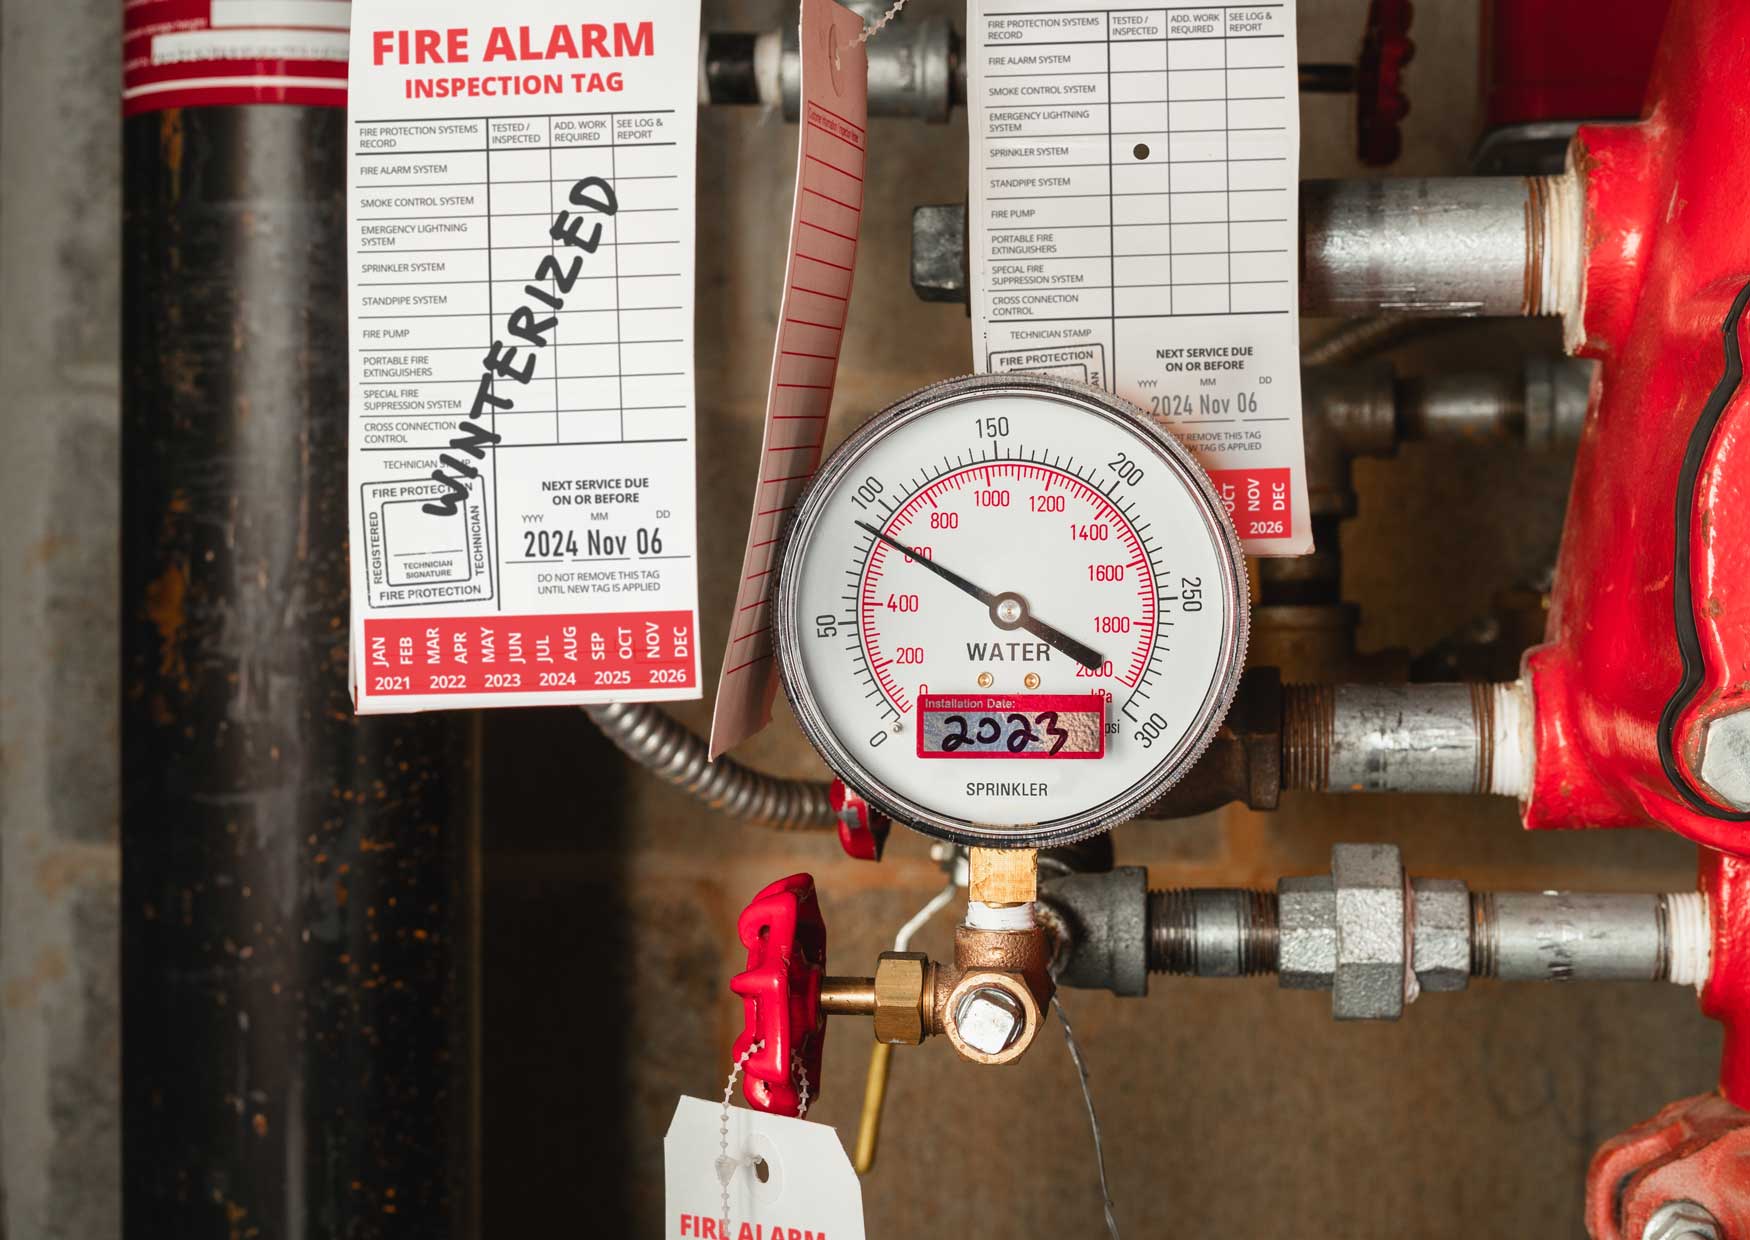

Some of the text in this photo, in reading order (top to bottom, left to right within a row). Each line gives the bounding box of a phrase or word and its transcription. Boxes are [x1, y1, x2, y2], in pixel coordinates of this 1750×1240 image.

[987, 17, 1100, 29] FIRE PROTECTION SYSTEMS
[988, 30, 1023, 40] RECORD
[372, 21, 655, 66] FIRE ALARM
[405, 71, 624, 99] INSPECTION TAG
[492, 123, 523, 133] TESTED
[554, 119, 607, 131] ADD. WORK
[616, 117, 654, 128] SEE LOG
[359, 124, 478, 136] FIRE PROTECTION SYSTEMS
[554, 131, 601, 143] REQUIRED
[617, 130, 653, 140] REPORT
[359, 138, 397, 149] RECORD
[492, 134, 541, 144] INSPECTED
[990, 146, 1069, 158] SPRINKLER SYSTEM
[360, 164, 448, 175] FIRE ALARM SYSTEM
[360, 196, 475, 208] SMOKE CONTROL SYSTEM
[361, 223, 468, 235] EMERGENCY LIGHTNING
[361, 236, 396, 247] SYSTEM
[361, 262, 446, 273] SPRINKLER SYSTEM
[362, 295, 448, 306] STANDPIPE SYSTEM
[362, 329, 410, 339] FIRE PUMP
[1010, 329, 1092, 340] TECHNICIAN STAMP
[422, 176, 618, 516] WINTERIZED
[1156, 346, 1254, 359] NEXT SERVICE DUE
[363, 355, 429, 366] PORTABLE FIRE
[999, 350, 1094, 366] FIRE PROTECTION
[363, 367, 433, 378] EXTINGUISHERS
[1165, 360, 1245, 372] ON OR BEFORE
[1137, 379, 1158, 389] YYYY
[1199, 378, 1217, 386] MM
[1258, 376, 1273, 385] DD
[363, 388, 419, 399] SPECIAL FIRE
[363, 399, 462, 411] SUPPRESSION SYSTEM
[1151, 392, 1257, 417] 2024 Nov 06
[364, 421, 457, 432] CROSS CONNECTION
[975, 416, 1010, 439] 150
[364, 433, 408, 444] CONTROL
[1186, 432, 1222, 441] REMOVE
[1224, 431, 1243, 440] THIS
[1244, 431, 1262, 439] TAG
[1200, 444, 1217, 452] TAG
[1228, 442, 1262, 451] APPLIED
[383, 460, 438, 470] TECHNICIAN
[1108, 452, 1145, 487] 200
[372, 487, 398, 498] FIRE
[541, 478, 649, 493] NEXT SERVICE DUE
[552, 492, 640, 506] ON OR BEFORE
[851, 476, 885, 513] 100
[974, 490, 1011, 507] 1000
[1248, 478, 1261, 512] NOV
[1272, 482, 1285, 511] DEC
[1029, 495, 1066, 513] 1200
[521, 513, 544, 523] YYYY
[590, 511, 609, 521] MM
[655, 509, 671, 519] DD
[930, 512, 959, 529] 800
[1070, 524, 1109, 541] 1400
[1250, 521, 1284, 534] 2026
[369, 511, 384, 584] REGISTERED
[470, 505, 485, 577] TECHNICIAN
[524, 527, 663, 558] 2024 Nov 06
[403, 559, 453, 569] TECHNICIAN
[405, 570, 452, 579] SIGNATURE
[537, 570, 660, 582] DO NOT REMOVE THIS TAG
[1088, 564, 1124, 582] 1600
[379, 585, 482, 601] FIRE PROTECTION
[538, 582, 661, 595] UNTIL NEW TAG IS APPLIED
[1181, 576, 1202, 612] 250
[887, 594, 919, 612] 400
[816, 614, 837, 638] 50
[1094, 616, 1130, 634] 1800
[426, 627, 440, 664] MAR
[480, 626, 496, 663] MAY
[563, 625, 577, 661] AUG
[591, 632, 605, 661] SEP
[618, 627, 632, 659] OCT
[646, 621, 660, 658] NOV
[673, 626, 687, 657] DEC
[372, 637, 390, 668] JAN
[400, 636, 413, 665] FEB
[454, 631, 468, 664] APR
[508, 632, 526, 664] JUN
[536, 635, 554, 663] JUL
[966, 642, 1051, 662] WATER
[896, 647, 924, 665] 200
[374, 669, 687, 691] 2021 2022 2023 2024 2025 2026
[924, 699, 1015, 709] Installation Date:
[941, 711, 1069, 757] 2023
[1134, 713, 1169, 749] 300
[870, 730, 887, 748] 0
[966, 782, 1048, 797] SPRINKLER
